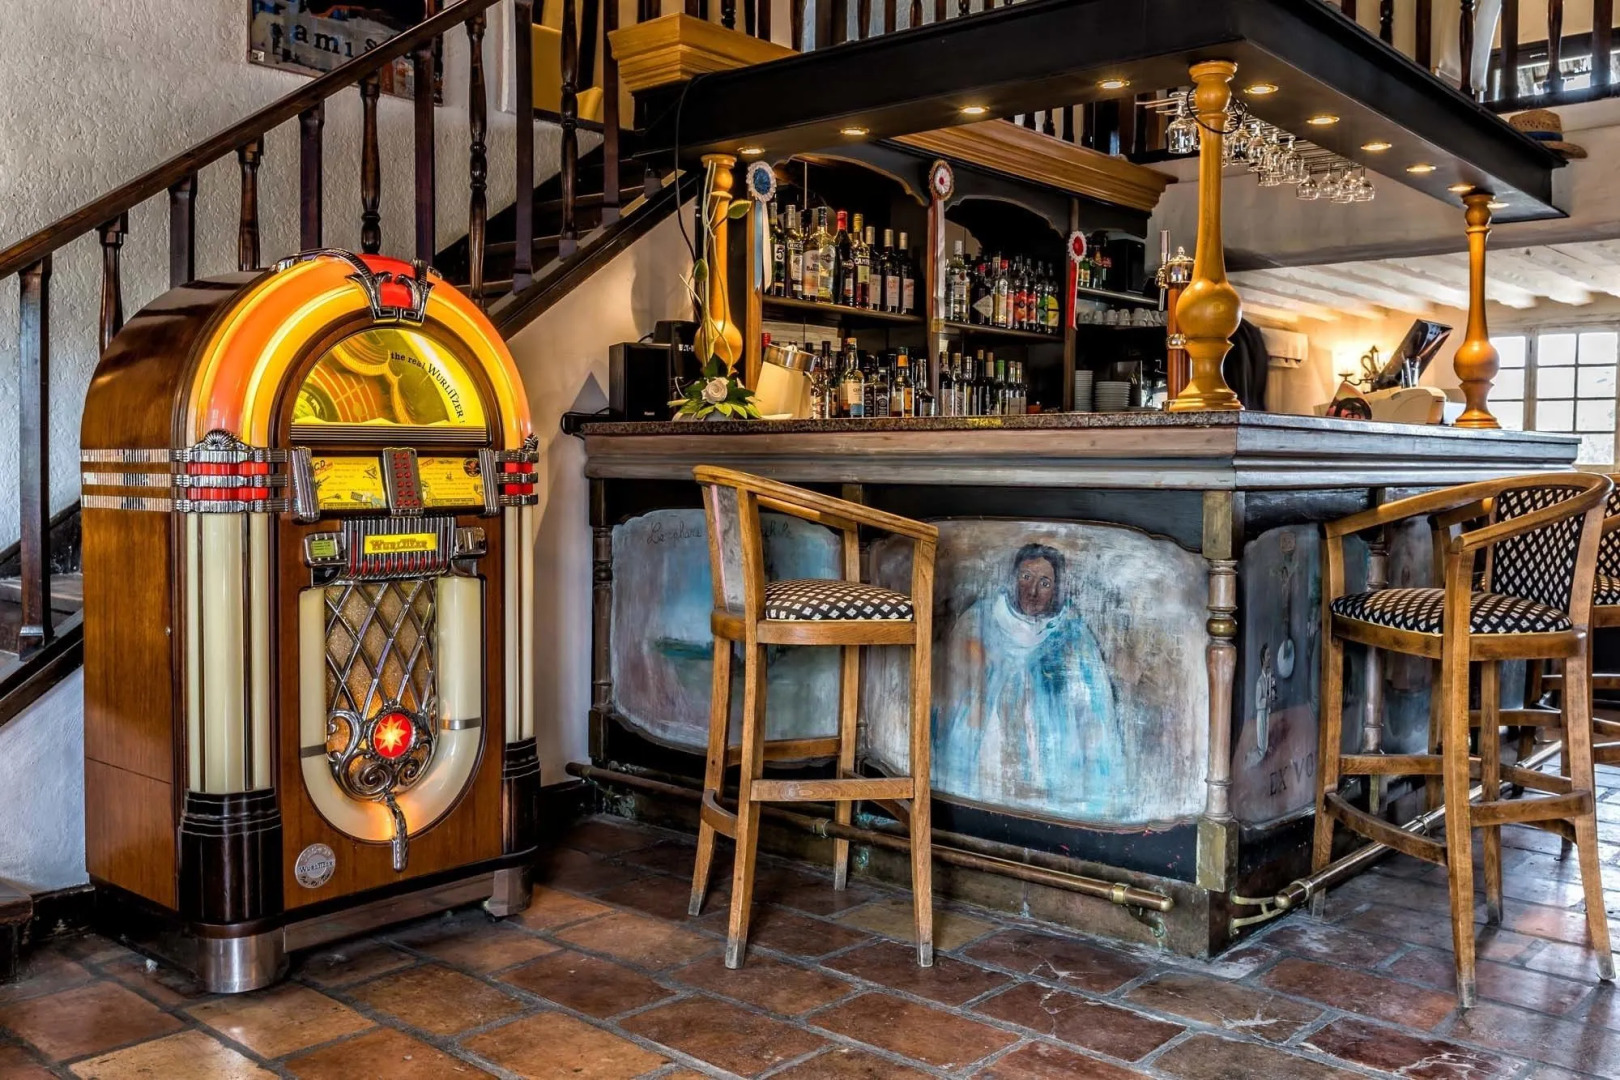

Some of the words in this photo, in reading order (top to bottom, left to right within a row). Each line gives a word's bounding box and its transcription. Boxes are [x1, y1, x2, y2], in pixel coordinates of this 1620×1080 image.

[391, 351, 406, 361] the
[408, 356, 426, 370] real
[1270, 766, 1288, 796] EX
